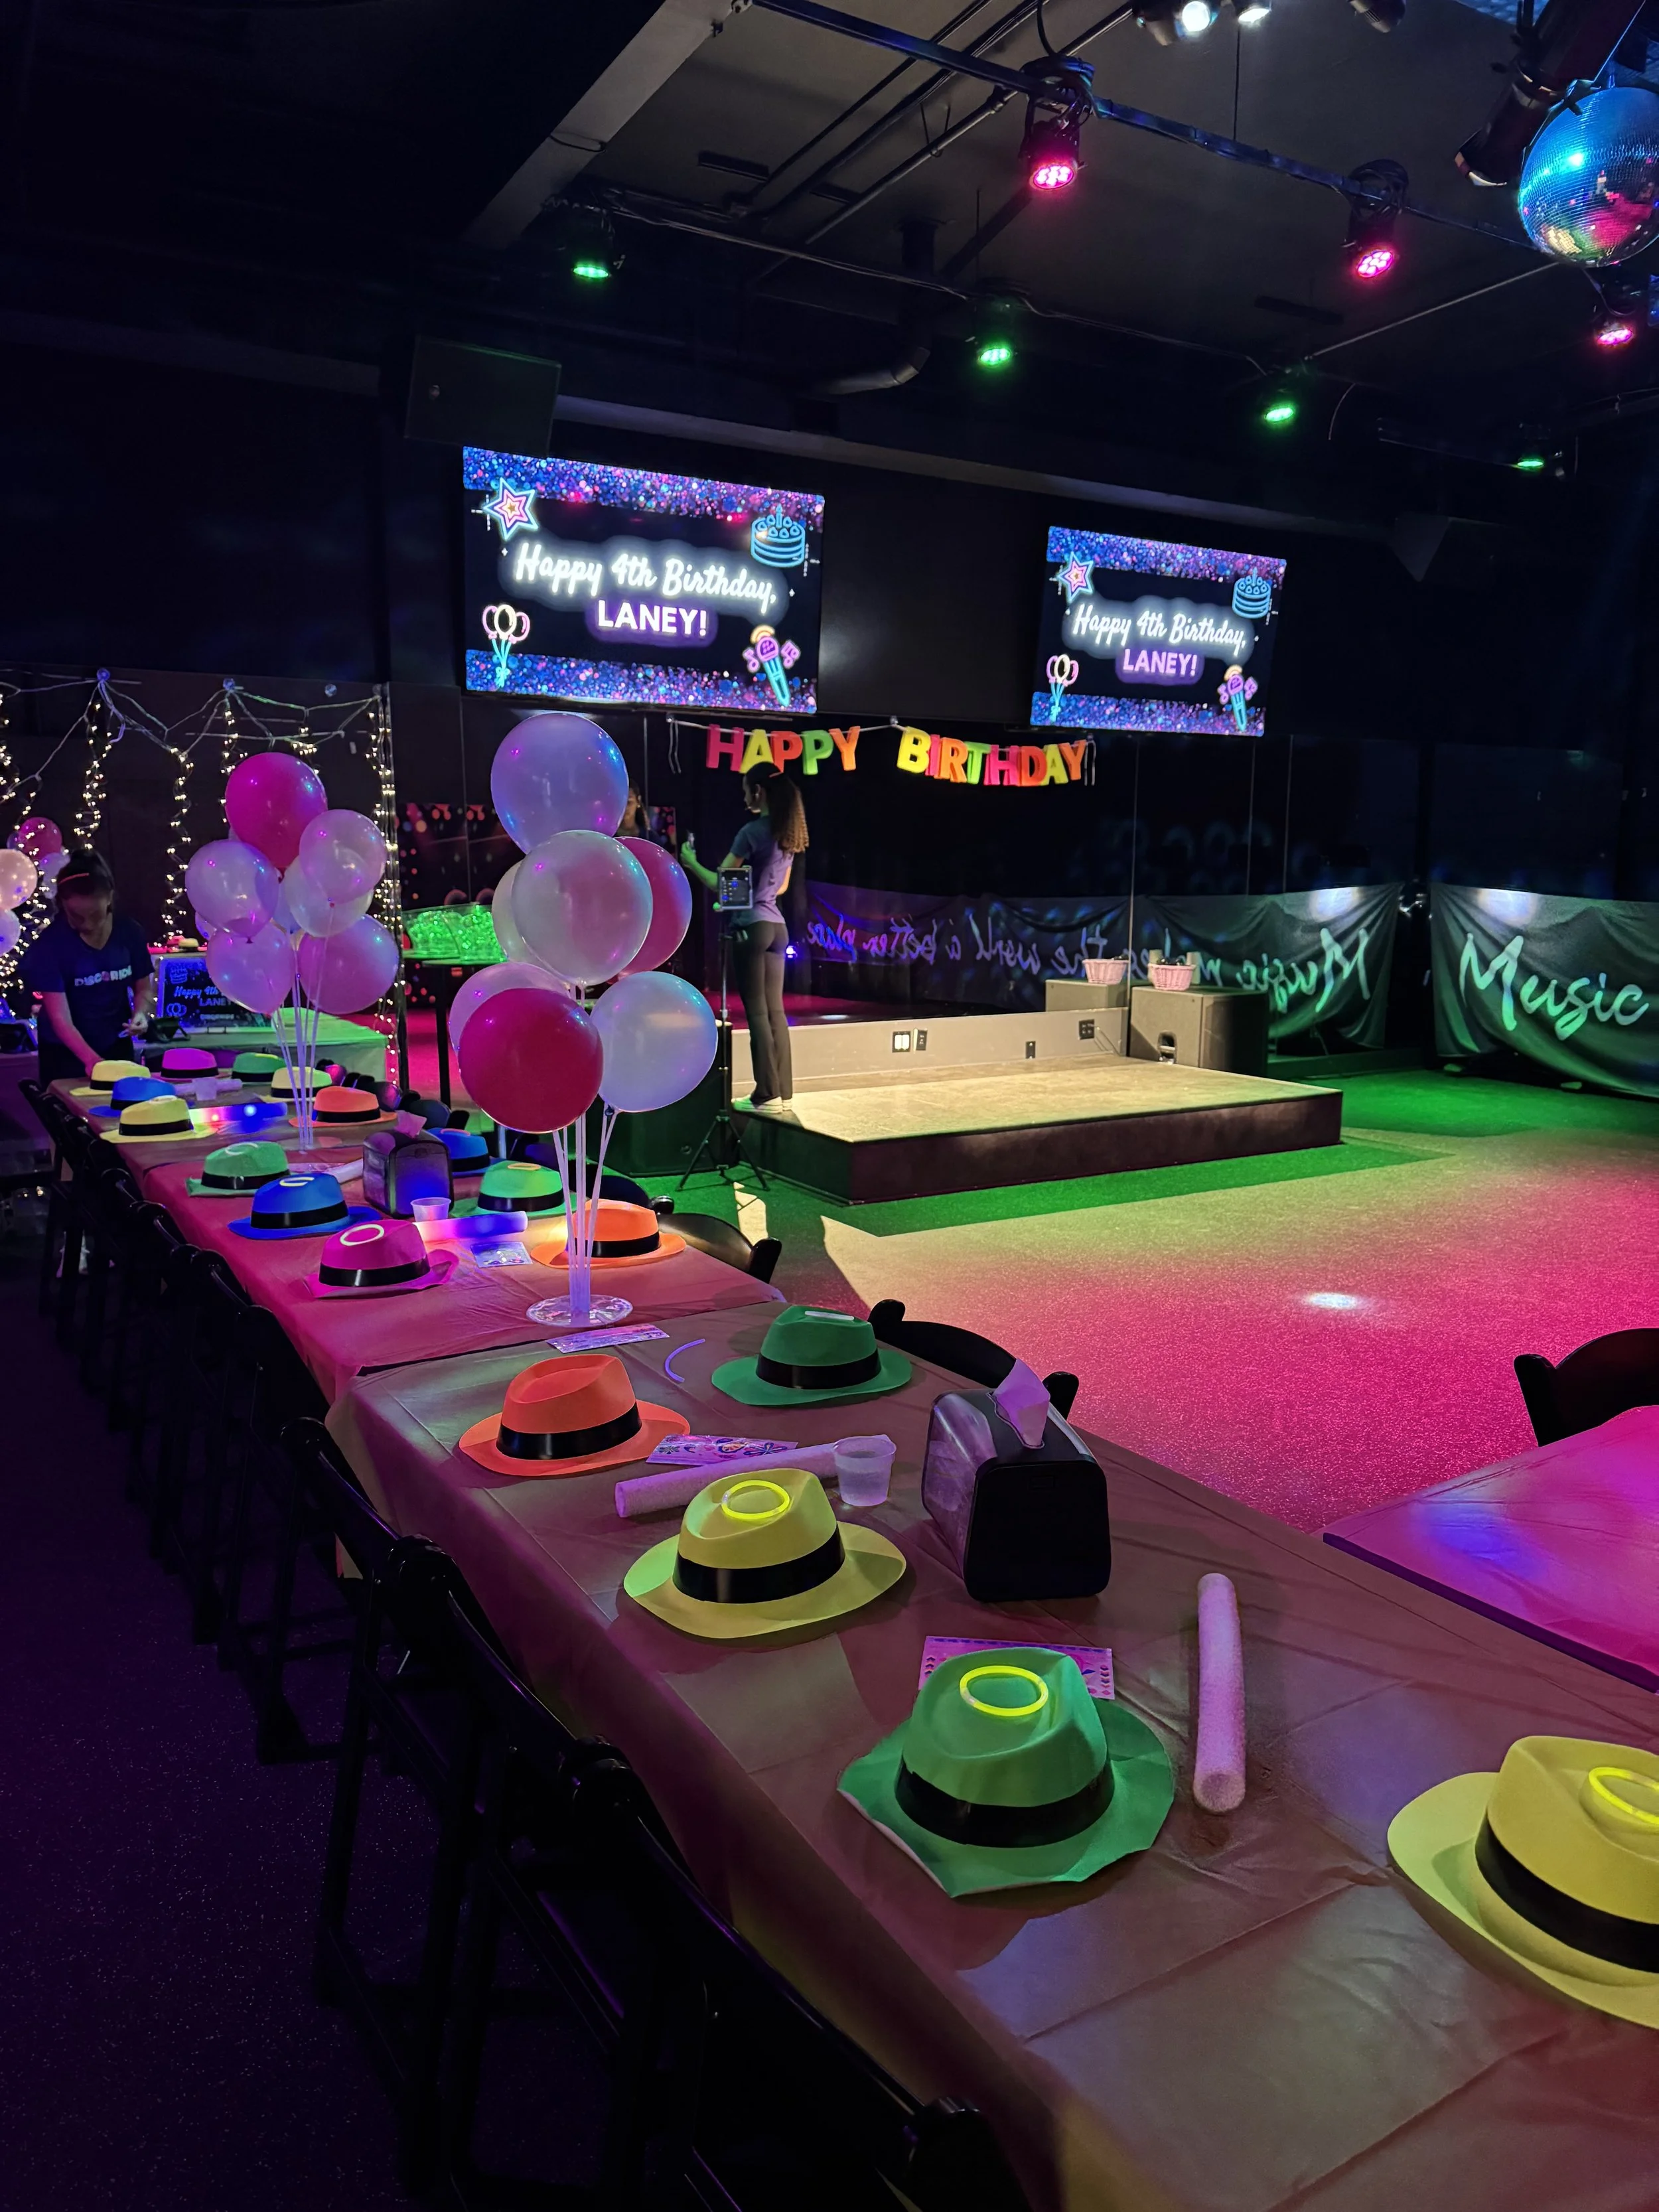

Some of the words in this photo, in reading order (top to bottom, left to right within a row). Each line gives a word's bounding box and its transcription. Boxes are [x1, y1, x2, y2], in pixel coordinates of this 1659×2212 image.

[516, 542, 603, 596] Happy
[611, 553, 658, 588] 4th
[663, 558, 777, 614] Birthday,
[597, 600, 707, 636] LANEY!
[1072, 604, 1131, 646] Happy
[1136, 611, 1168, 637] 4th
[1169, 613, 1246, 657] Birthday,
[1123, 648, 1198, 676] LANEY!
[706, 724, 861, 775] HAPPY
[897, 726, 1087, 786] BIRTHDAY
[174, 986, 202, 999] Happy
[1459, 932, 1650, 1041] Music
